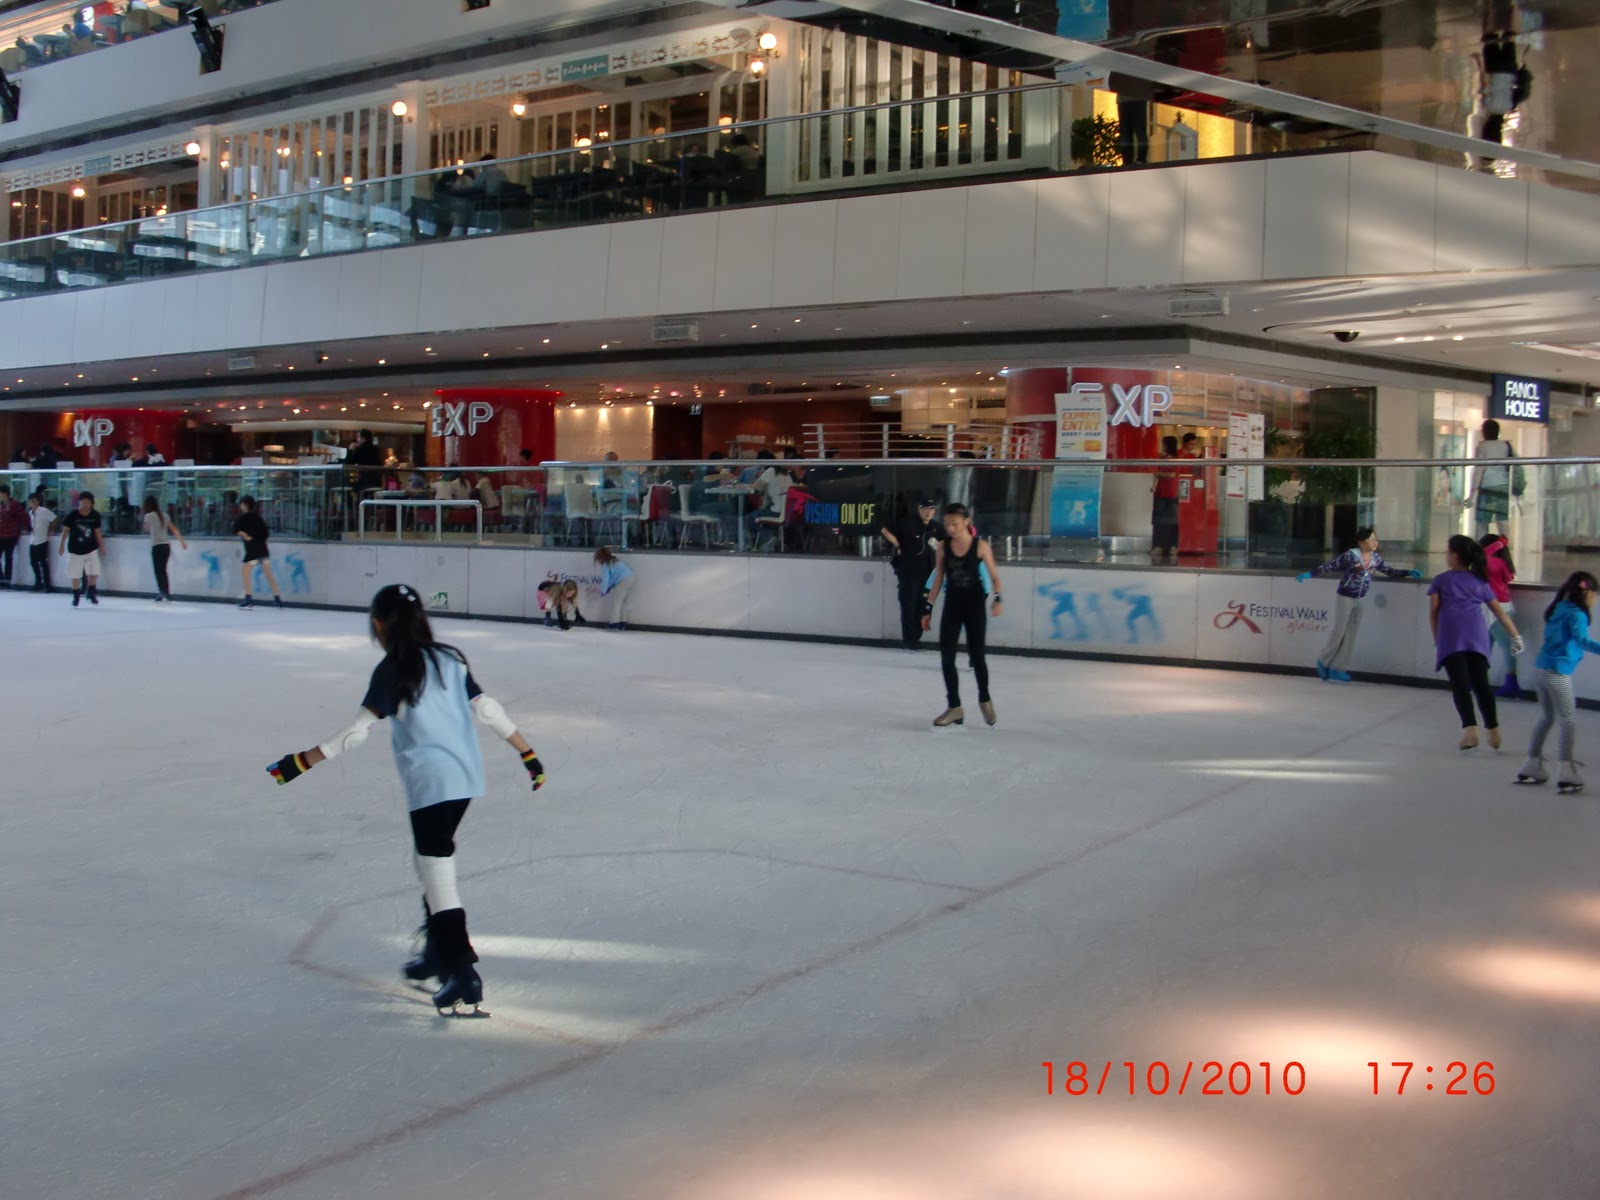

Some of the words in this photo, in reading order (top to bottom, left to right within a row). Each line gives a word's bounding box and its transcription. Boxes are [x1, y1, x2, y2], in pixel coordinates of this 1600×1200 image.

[1505, 380, 1540, 400] FANCL
[1071, 382, 1173, 428] XP
[1504, 399, 1540, 418] HOUSE
[432, 401, 494, 437] EXP
[1061, 420, 1101, 431] ENTRY
[804, 503, 839, 523] VISION
[841, 503, 856, 524] ON
[1249, 603, 1295, 619] FESTIVAL
[1296, 606, 1328, 621] WALK
[1287, 619, 1328, 635] glacier
